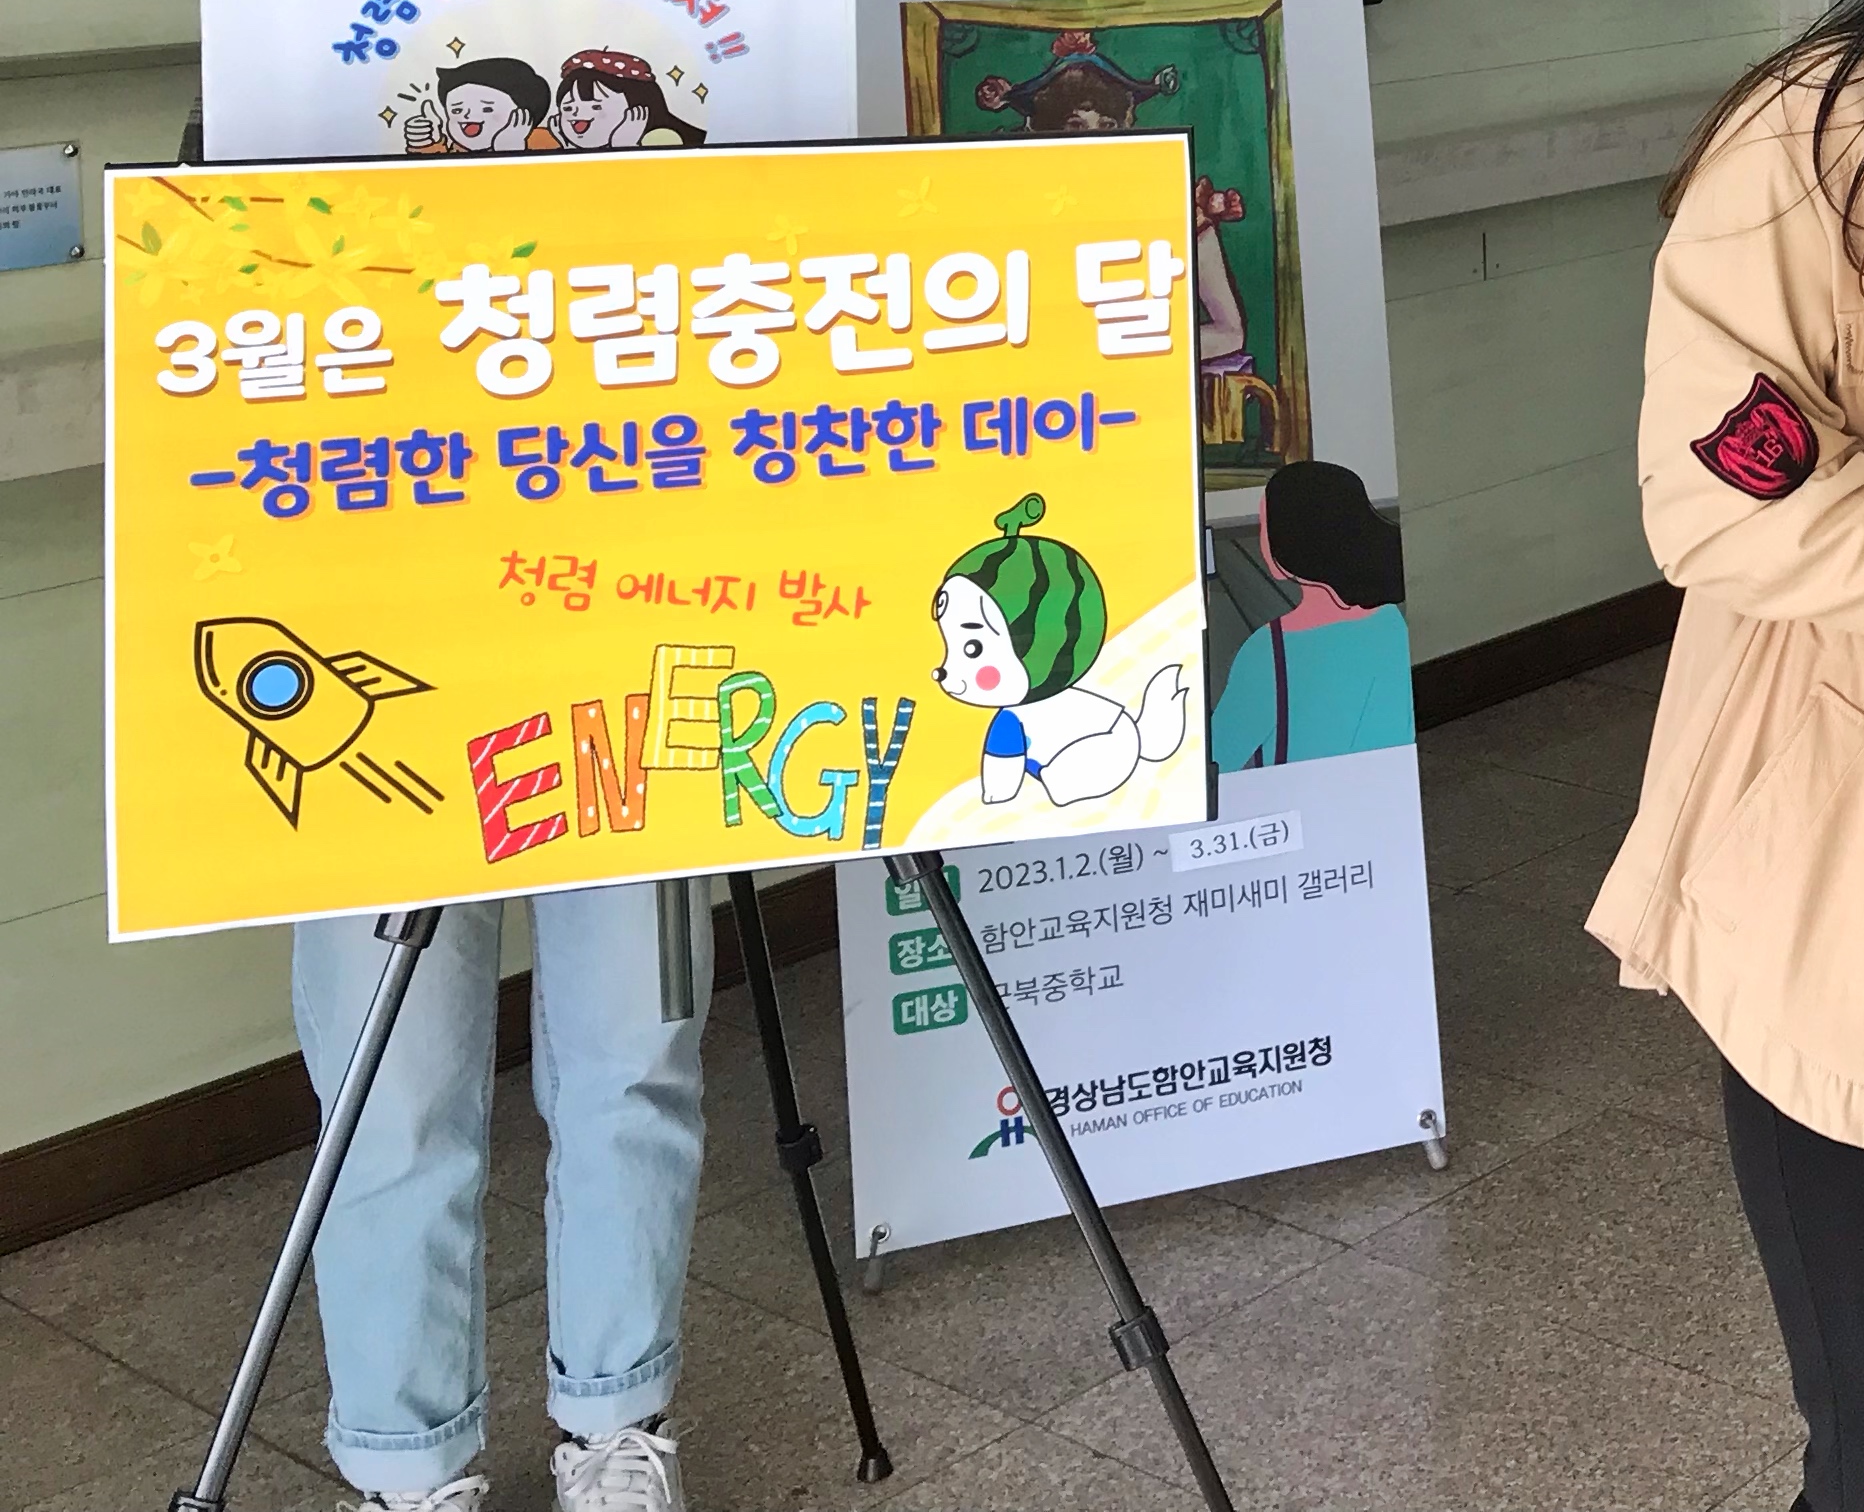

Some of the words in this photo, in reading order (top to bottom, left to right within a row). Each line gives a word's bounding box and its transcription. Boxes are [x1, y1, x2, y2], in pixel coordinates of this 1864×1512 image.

[155, 303, 396, 403] 3월은
[434, 246, 1034, 400] 청렴충전의
[1076, 238, 1187, 360] 달
[496, 411, 711, 504] 당신을
[731, 398, 944, 484] 칭찬한
[497, 549, 599, 617] 청렴
[615, 560, 758, 614] 에너지
[780, 570, 873, 627] 발사
[465, 642, 916, 865] ENERGY
[978, 842, 1144, 894] 2023.1.2.(월)
[1190, 820, 1290, 860] 3.31.(금)
[980, 893, 1173, 954] 함안교육지원청
[1183, 874, 1288, 918] 재미새미
[1298, 860, 1374, 900] 갤러리
[901, 989, 959, 1026] 대상
[1045, 1035, 1333, 1117] 경상남도함안교육지원청
[1070, 1114, 1127, 1137] HAMAN
[1133, 1102, 1187, 1125] OFFICE
[1192, 1096, 1213, 1113] OF
[1219, 1080, 1302, 1108] EDUCATION
